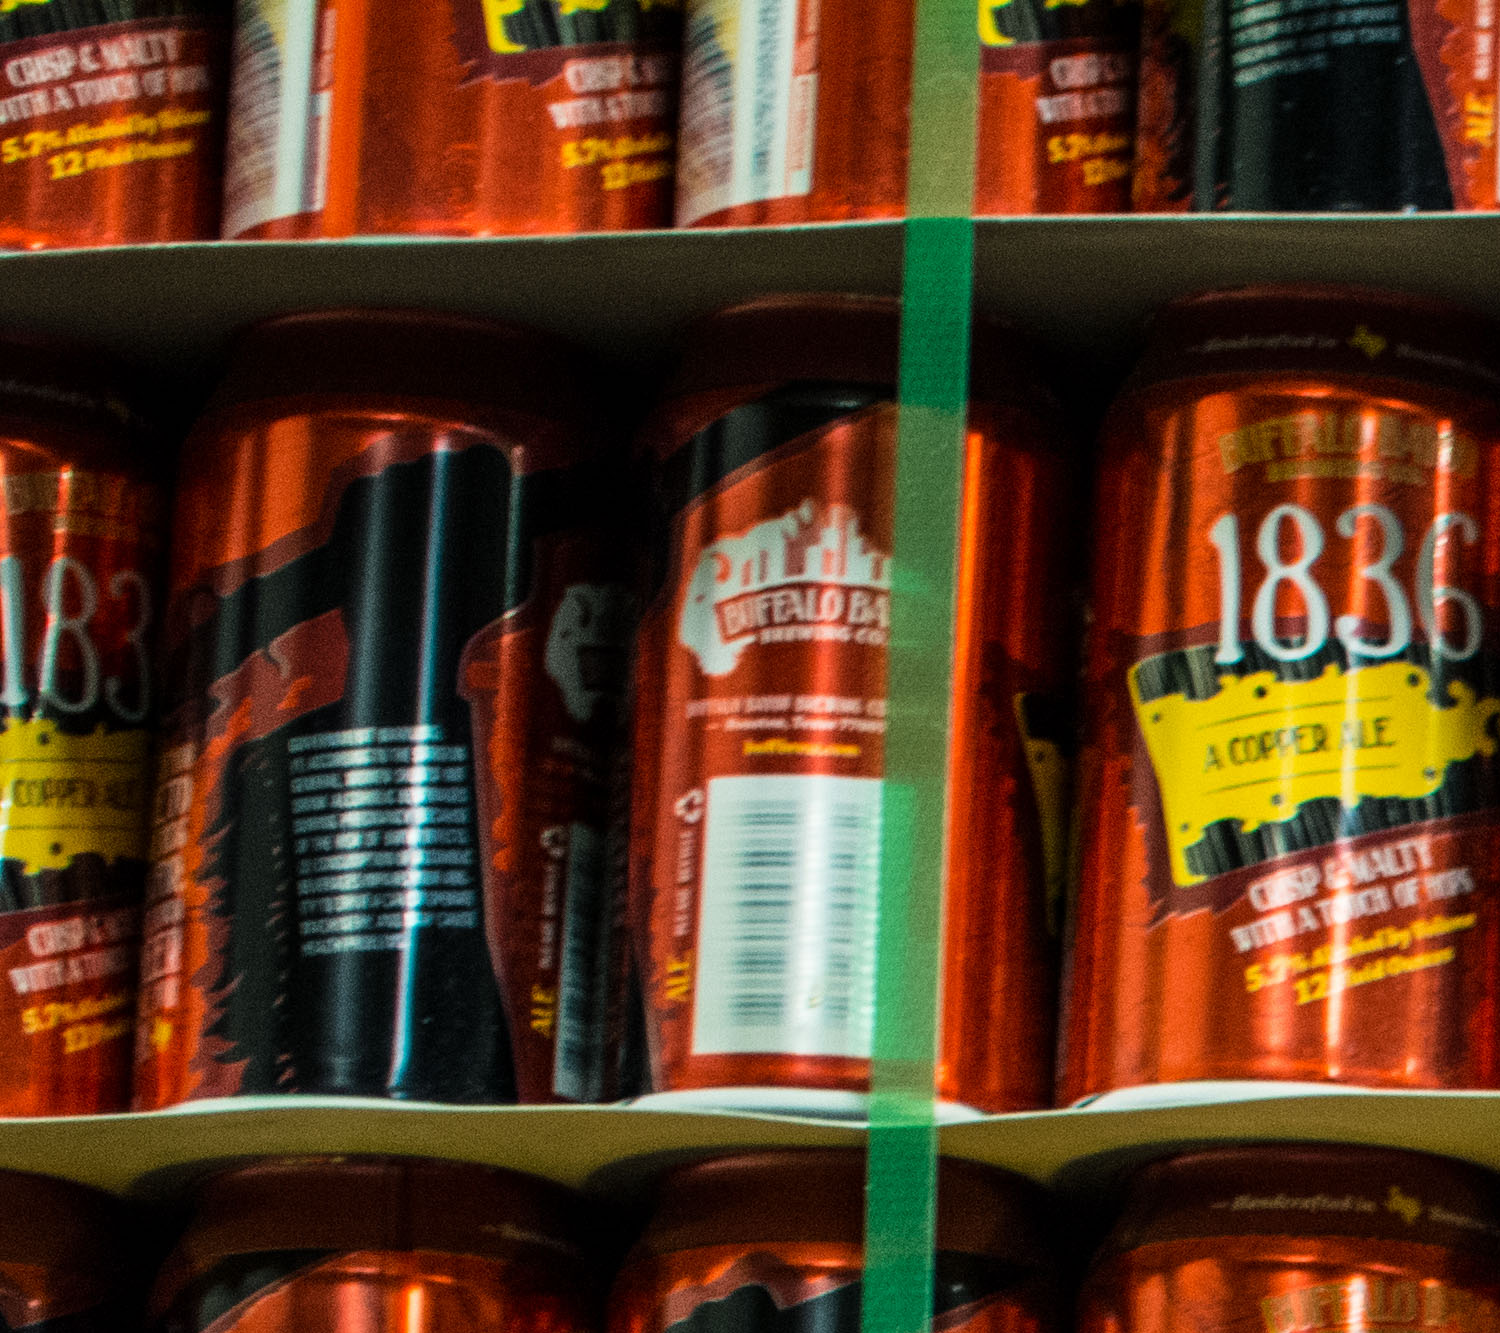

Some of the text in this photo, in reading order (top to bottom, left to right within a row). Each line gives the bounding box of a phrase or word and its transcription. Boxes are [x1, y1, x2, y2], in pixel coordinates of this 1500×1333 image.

[1209, 503, 1481, 664] 1836
[1228, 725, 1330, 768] COPPER
[1338, 715, 1395, 753] ALE
